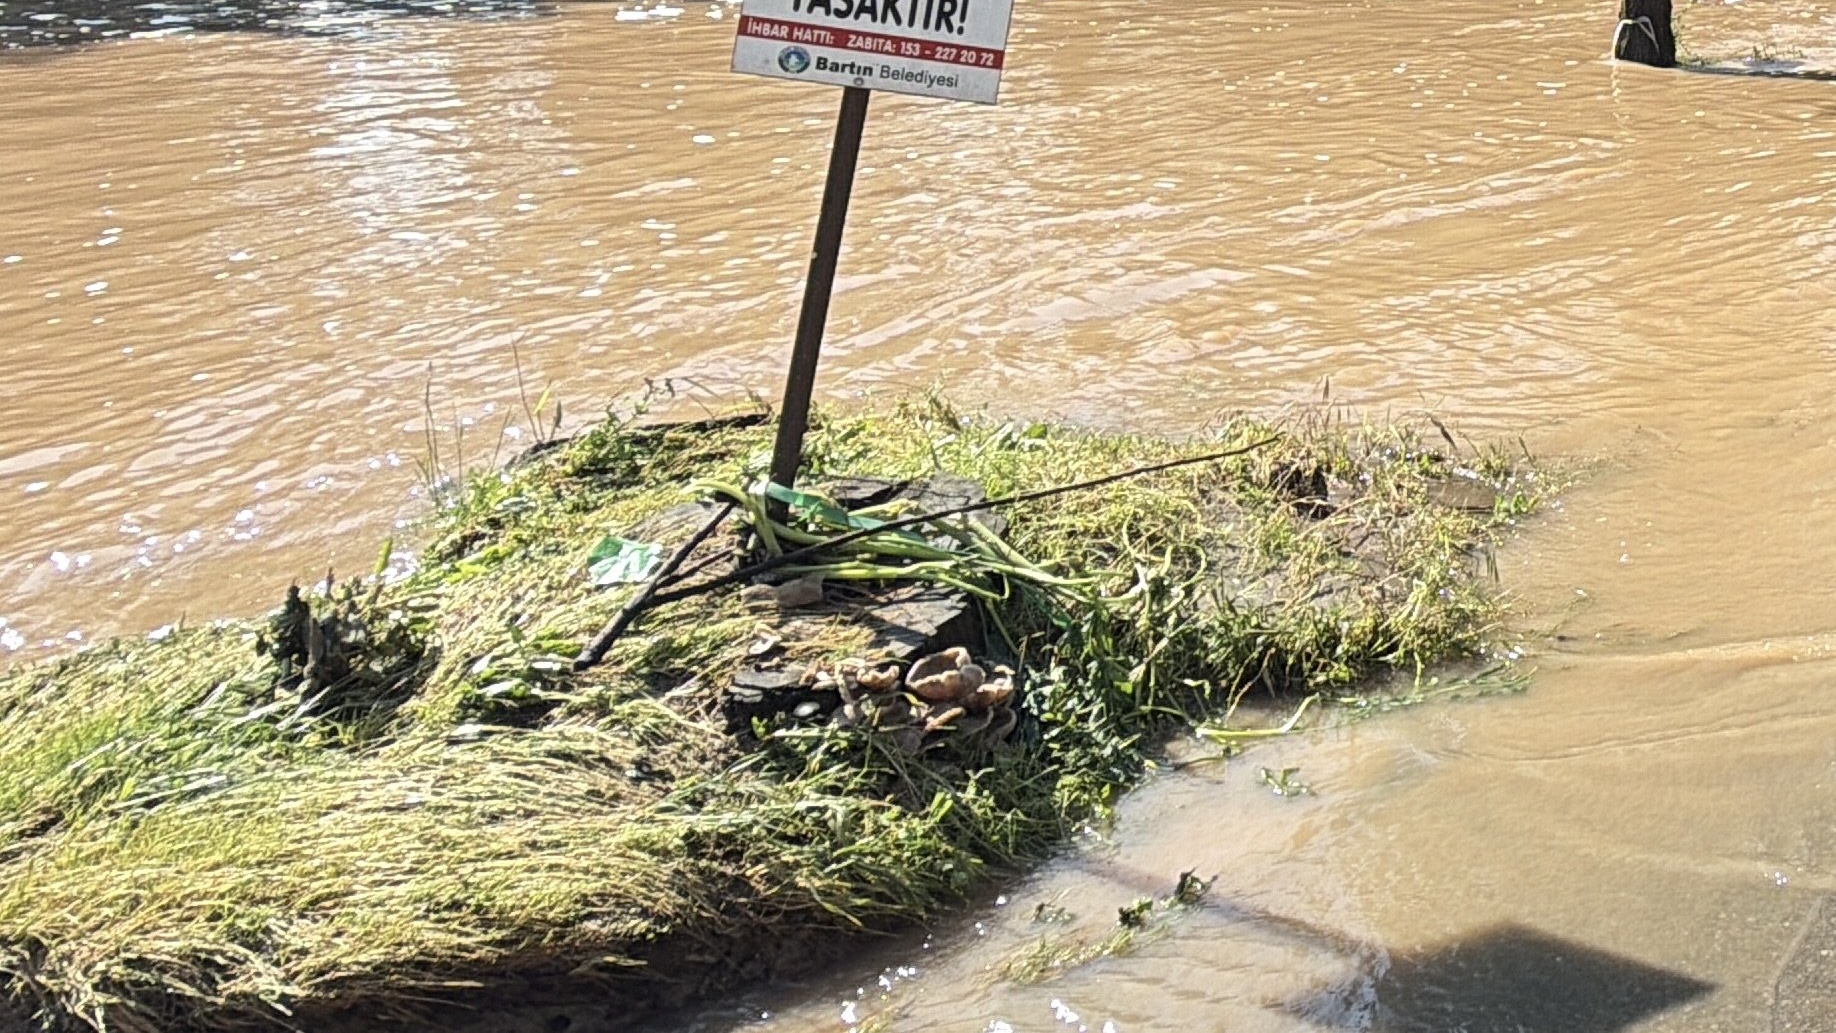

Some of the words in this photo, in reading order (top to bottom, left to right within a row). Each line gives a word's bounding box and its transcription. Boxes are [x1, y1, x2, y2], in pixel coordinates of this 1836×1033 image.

[747, 17, 789, 39] İHBAR
[792, 26, 834, 45] HATTI:
[846, 34, 896, 54] ZABITA:
[900, 41, 921, 57] 153
[934, 46, 957, 62] 227
[960, 49, 977, 64] 20
[980, 52, 995, 67] 72
[815, 55, 874, 77] Bartın
[880, 65, 960, 89] Belediyesi
